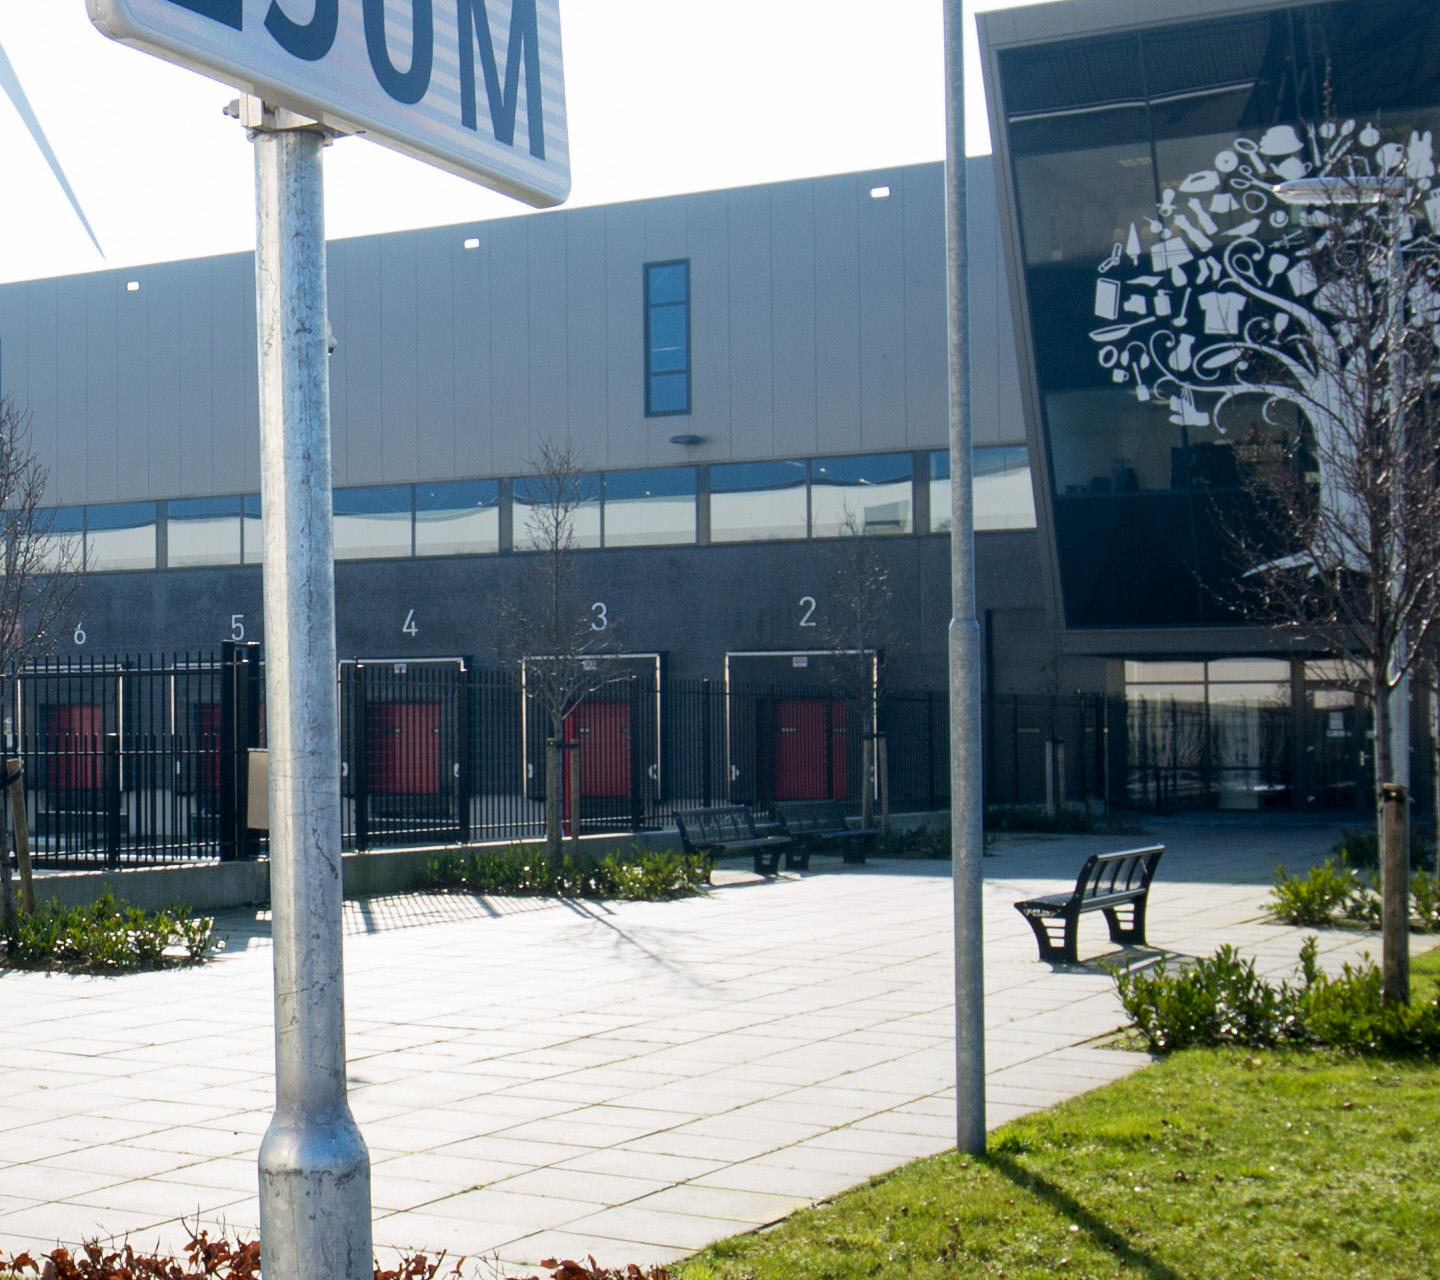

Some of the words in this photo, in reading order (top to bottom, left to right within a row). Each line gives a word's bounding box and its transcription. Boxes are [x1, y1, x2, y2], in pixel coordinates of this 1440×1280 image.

[402, 609, 419, 636] 4
[590, 601, 609, 632] 3
[799, 596, 817, 627] 2
[73, 622, 87, 645] 6
[230, 614, 245, 642] 5
